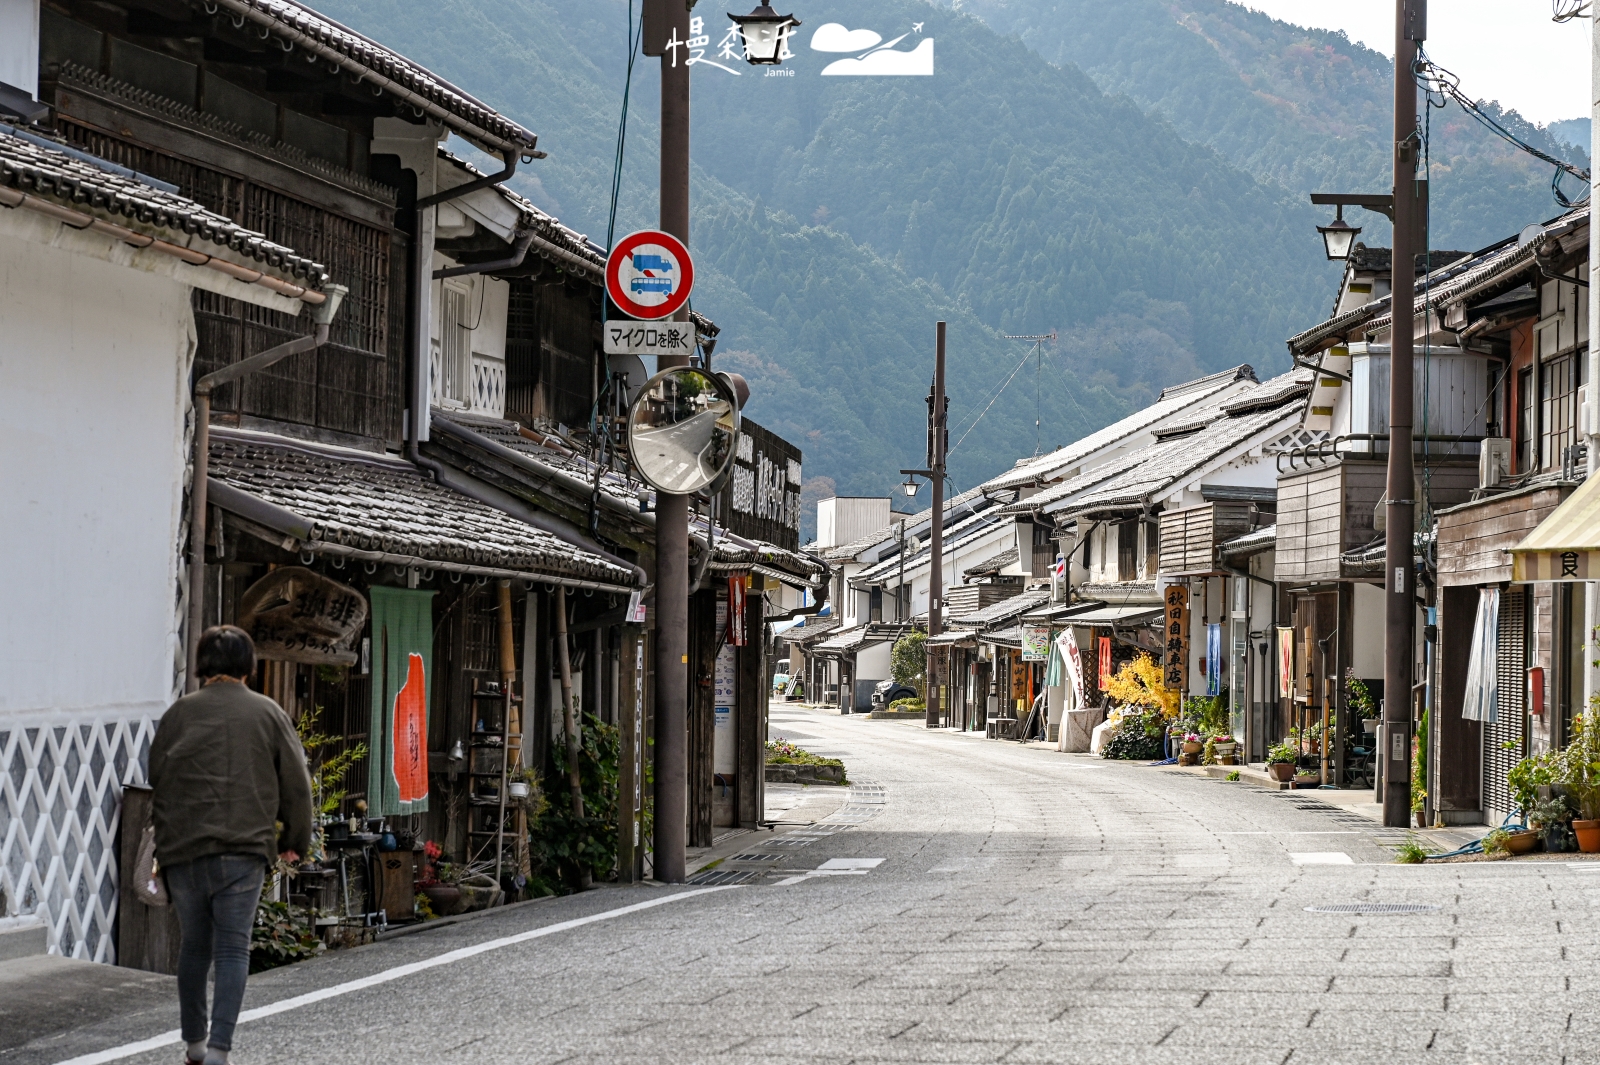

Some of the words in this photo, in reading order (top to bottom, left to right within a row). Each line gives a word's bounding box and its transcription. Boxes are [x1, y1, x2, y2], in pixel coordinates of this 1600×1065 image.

[610, 328, 688, 349] マイクロを除く
[1560, 551, 1579, 577] 食
[293, 588, 358, 628] 珈琲
[252, 618, 337, 654] おにのすみか
[1167, 592, 1184, 684] 秋田自轉車店
